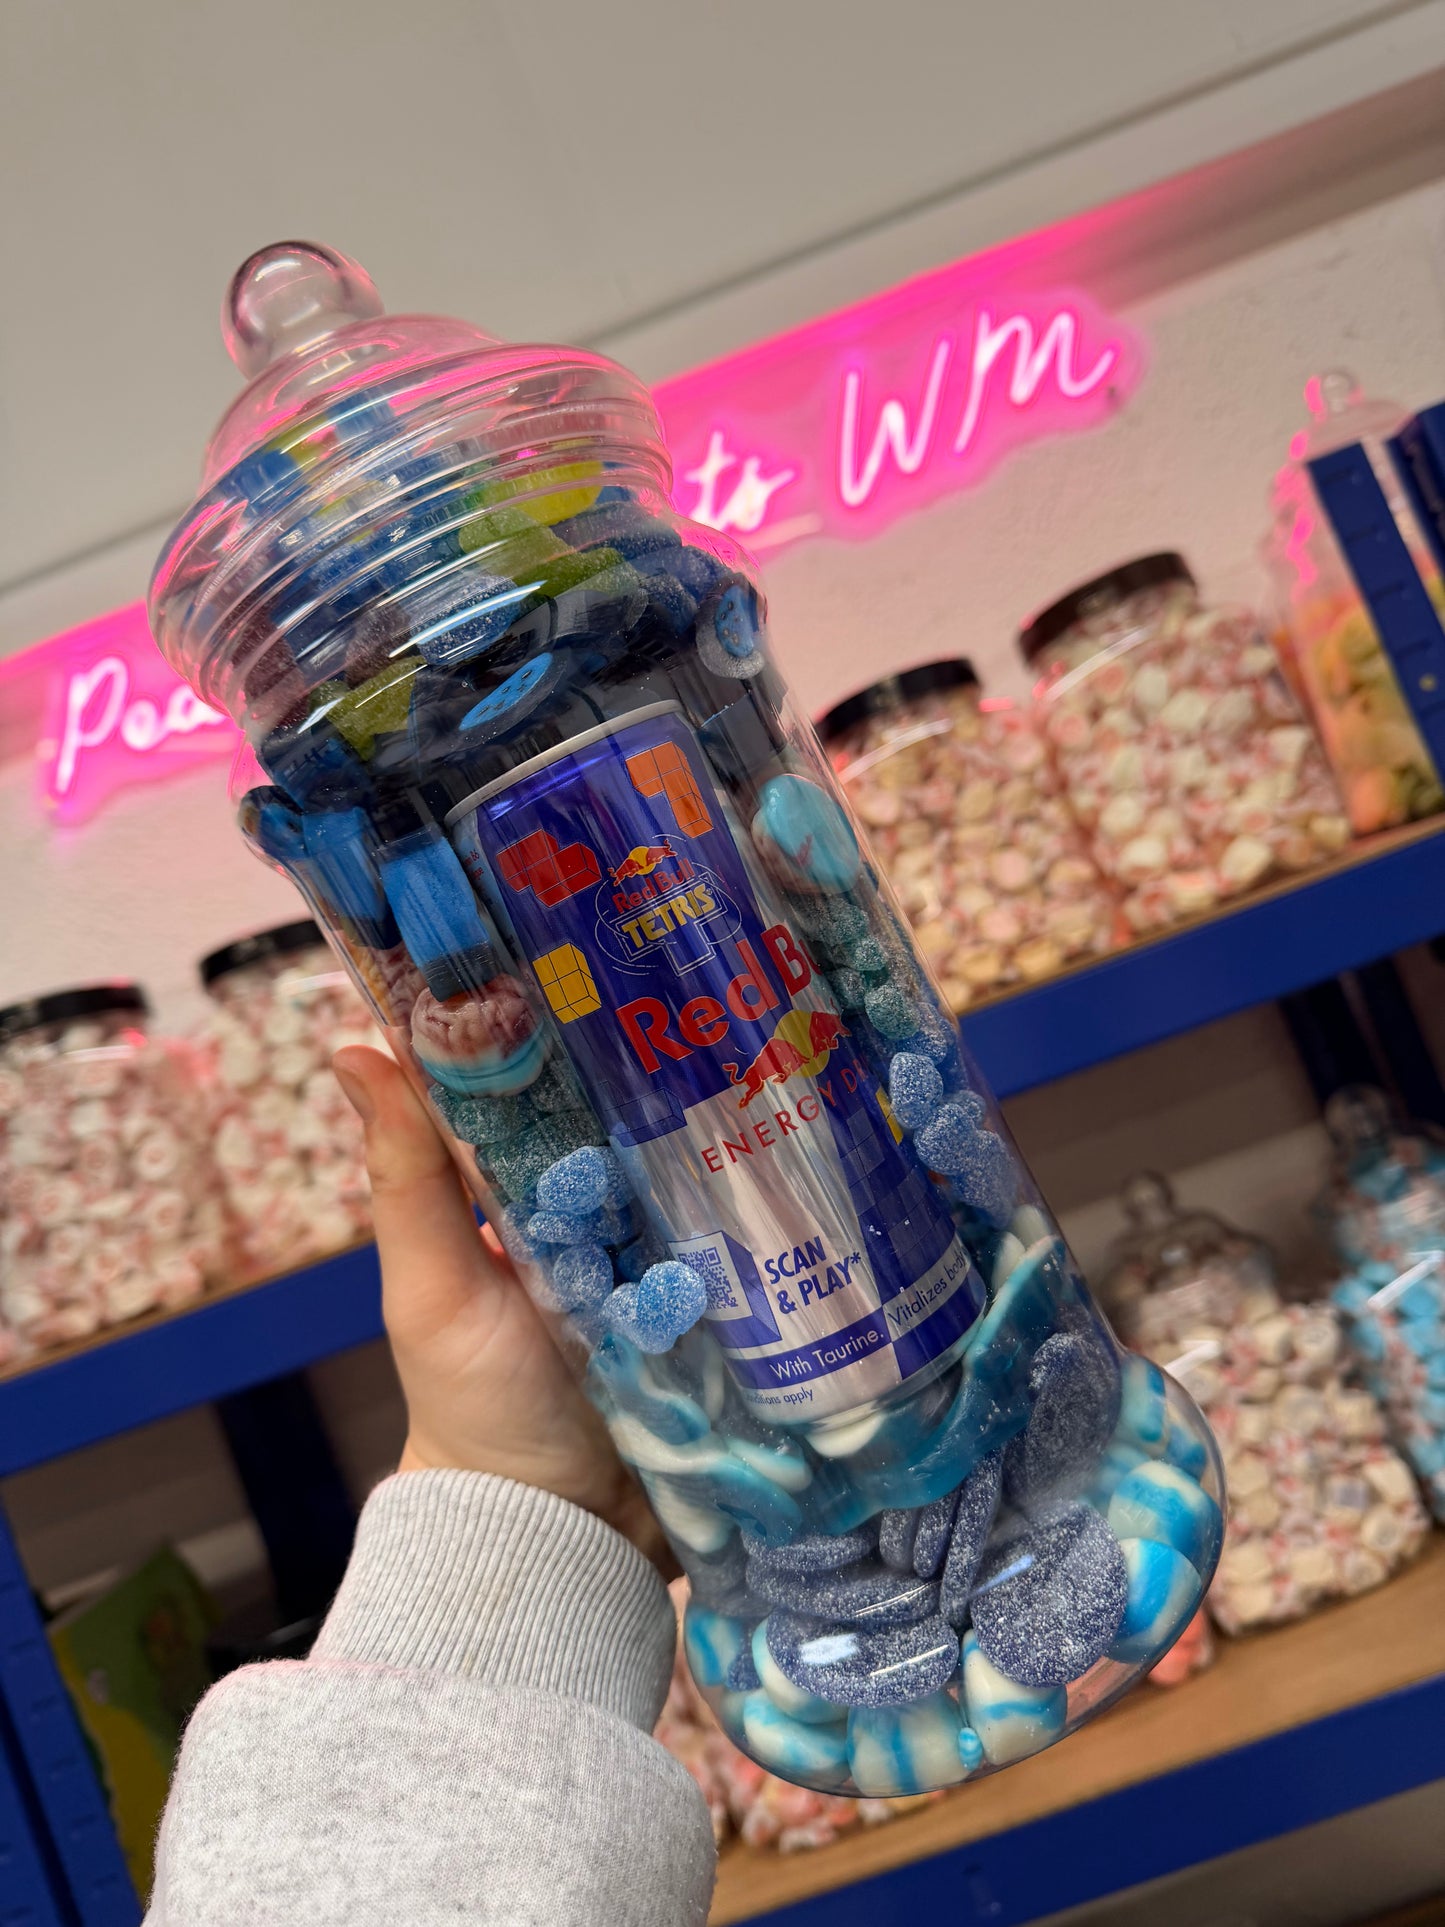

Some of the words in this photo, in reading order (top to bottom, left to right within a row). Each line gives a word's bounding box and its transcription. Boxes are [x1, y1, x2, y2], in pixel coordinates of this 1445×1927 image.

[612, 877, 658, 914] Red
[653, 858, 696, 893] Bull
[621, 883, 716, 949] TETRIS
[615, 938, 781, 1074] Red
[701, 1080, 837, 1174] ENERGY
[764, 1236, 828, 1285] SCAN
[769, 1355, 813, 1380] With
[812, 1330, 884, 1367] Taurine.
[887, 1277, 948, 1325] Vitalizes
[776, 1289, 798, 1315] &
[783, 1386, 814, 1405] apply
